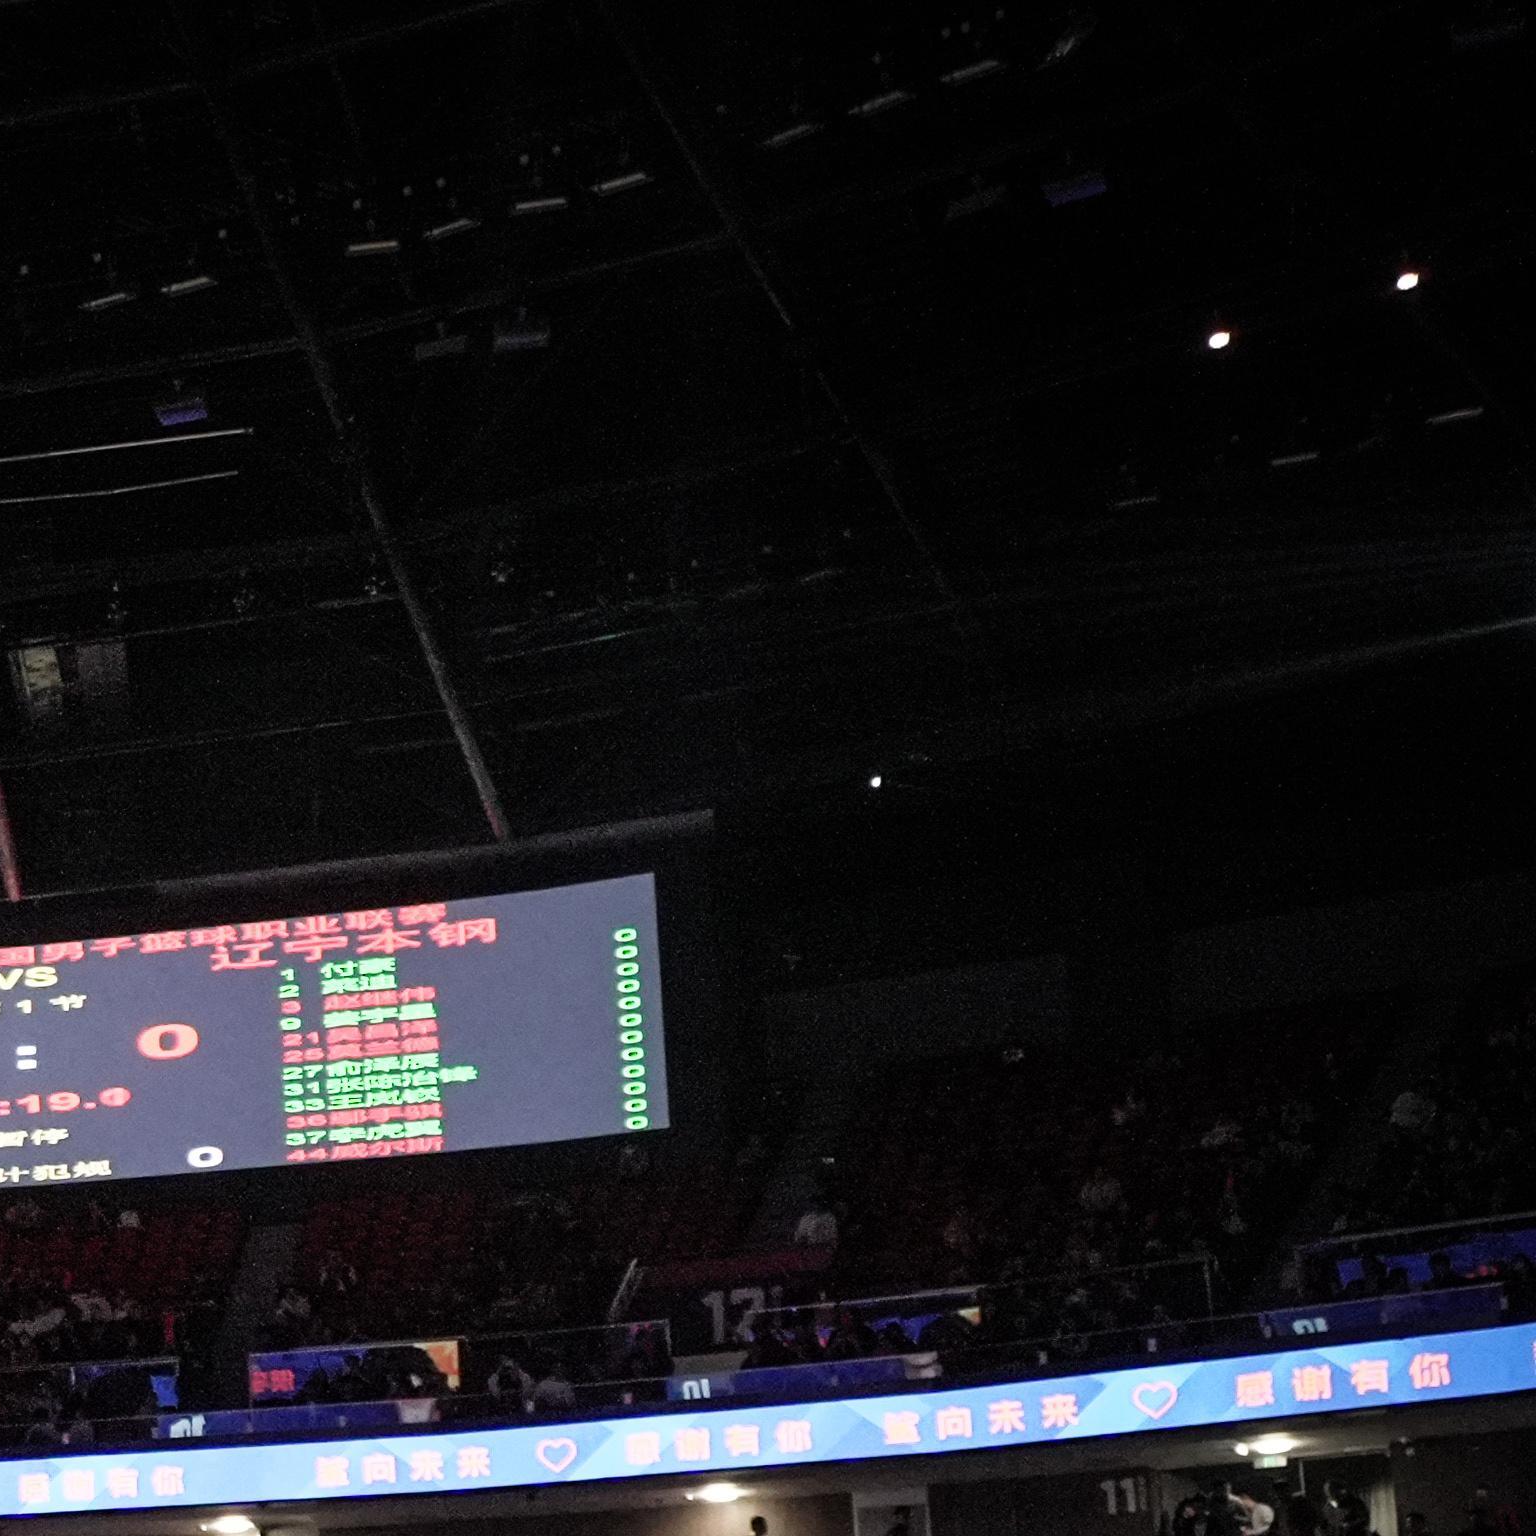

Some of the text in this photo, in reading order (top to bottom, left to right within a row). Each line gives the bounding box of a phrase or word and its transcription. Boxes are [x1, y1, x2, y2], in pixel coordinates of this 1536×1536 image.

[212, 916, 498, 971] 辽宁本钢
[280, 968, 294, 981] 1
[614, 929, 638, 944] 0
[279, 984, 300, 998] 2
[615, 945, 639, 960] 0
[280, 1000, 302, 1014] 3
[616, 962, 640, 977] 0
[280, 1017, 301, 1031] 9
[617, 979, 641, 994] 0
[282, 1032, 320, 1047] 21
[618, 996, 642, 1011] 0
[136, 1022, 200, 1060] 0
[282, 1048, 325, 1063] 25
[619, 1013, 643, 1028] 0
[283, 1064, 323, 1080] 27
[620, 1030, 644, 1045] 0
[284, 1081, 320, 1096] 31
[621, 1047, 645, 1062] 0
[285, 1098, 326, 1113] 33
[622, 1064, 646, 1079] 0
[285, 1130, 326, 1146] 37
[624, 1099, 648, 1114] 0
[286, 1114, 327, 1129] 36
[623, 1081, 647, 1096] 0
[187, 1146, 224, 1169] 0
[287, 1147, 327, 1161] 44
[625, 1115, 649, 1130] 0
[1234, 1352, 1455, 1409] 感谢有你
[625, 1420, 813, 1466] 感谢有你
